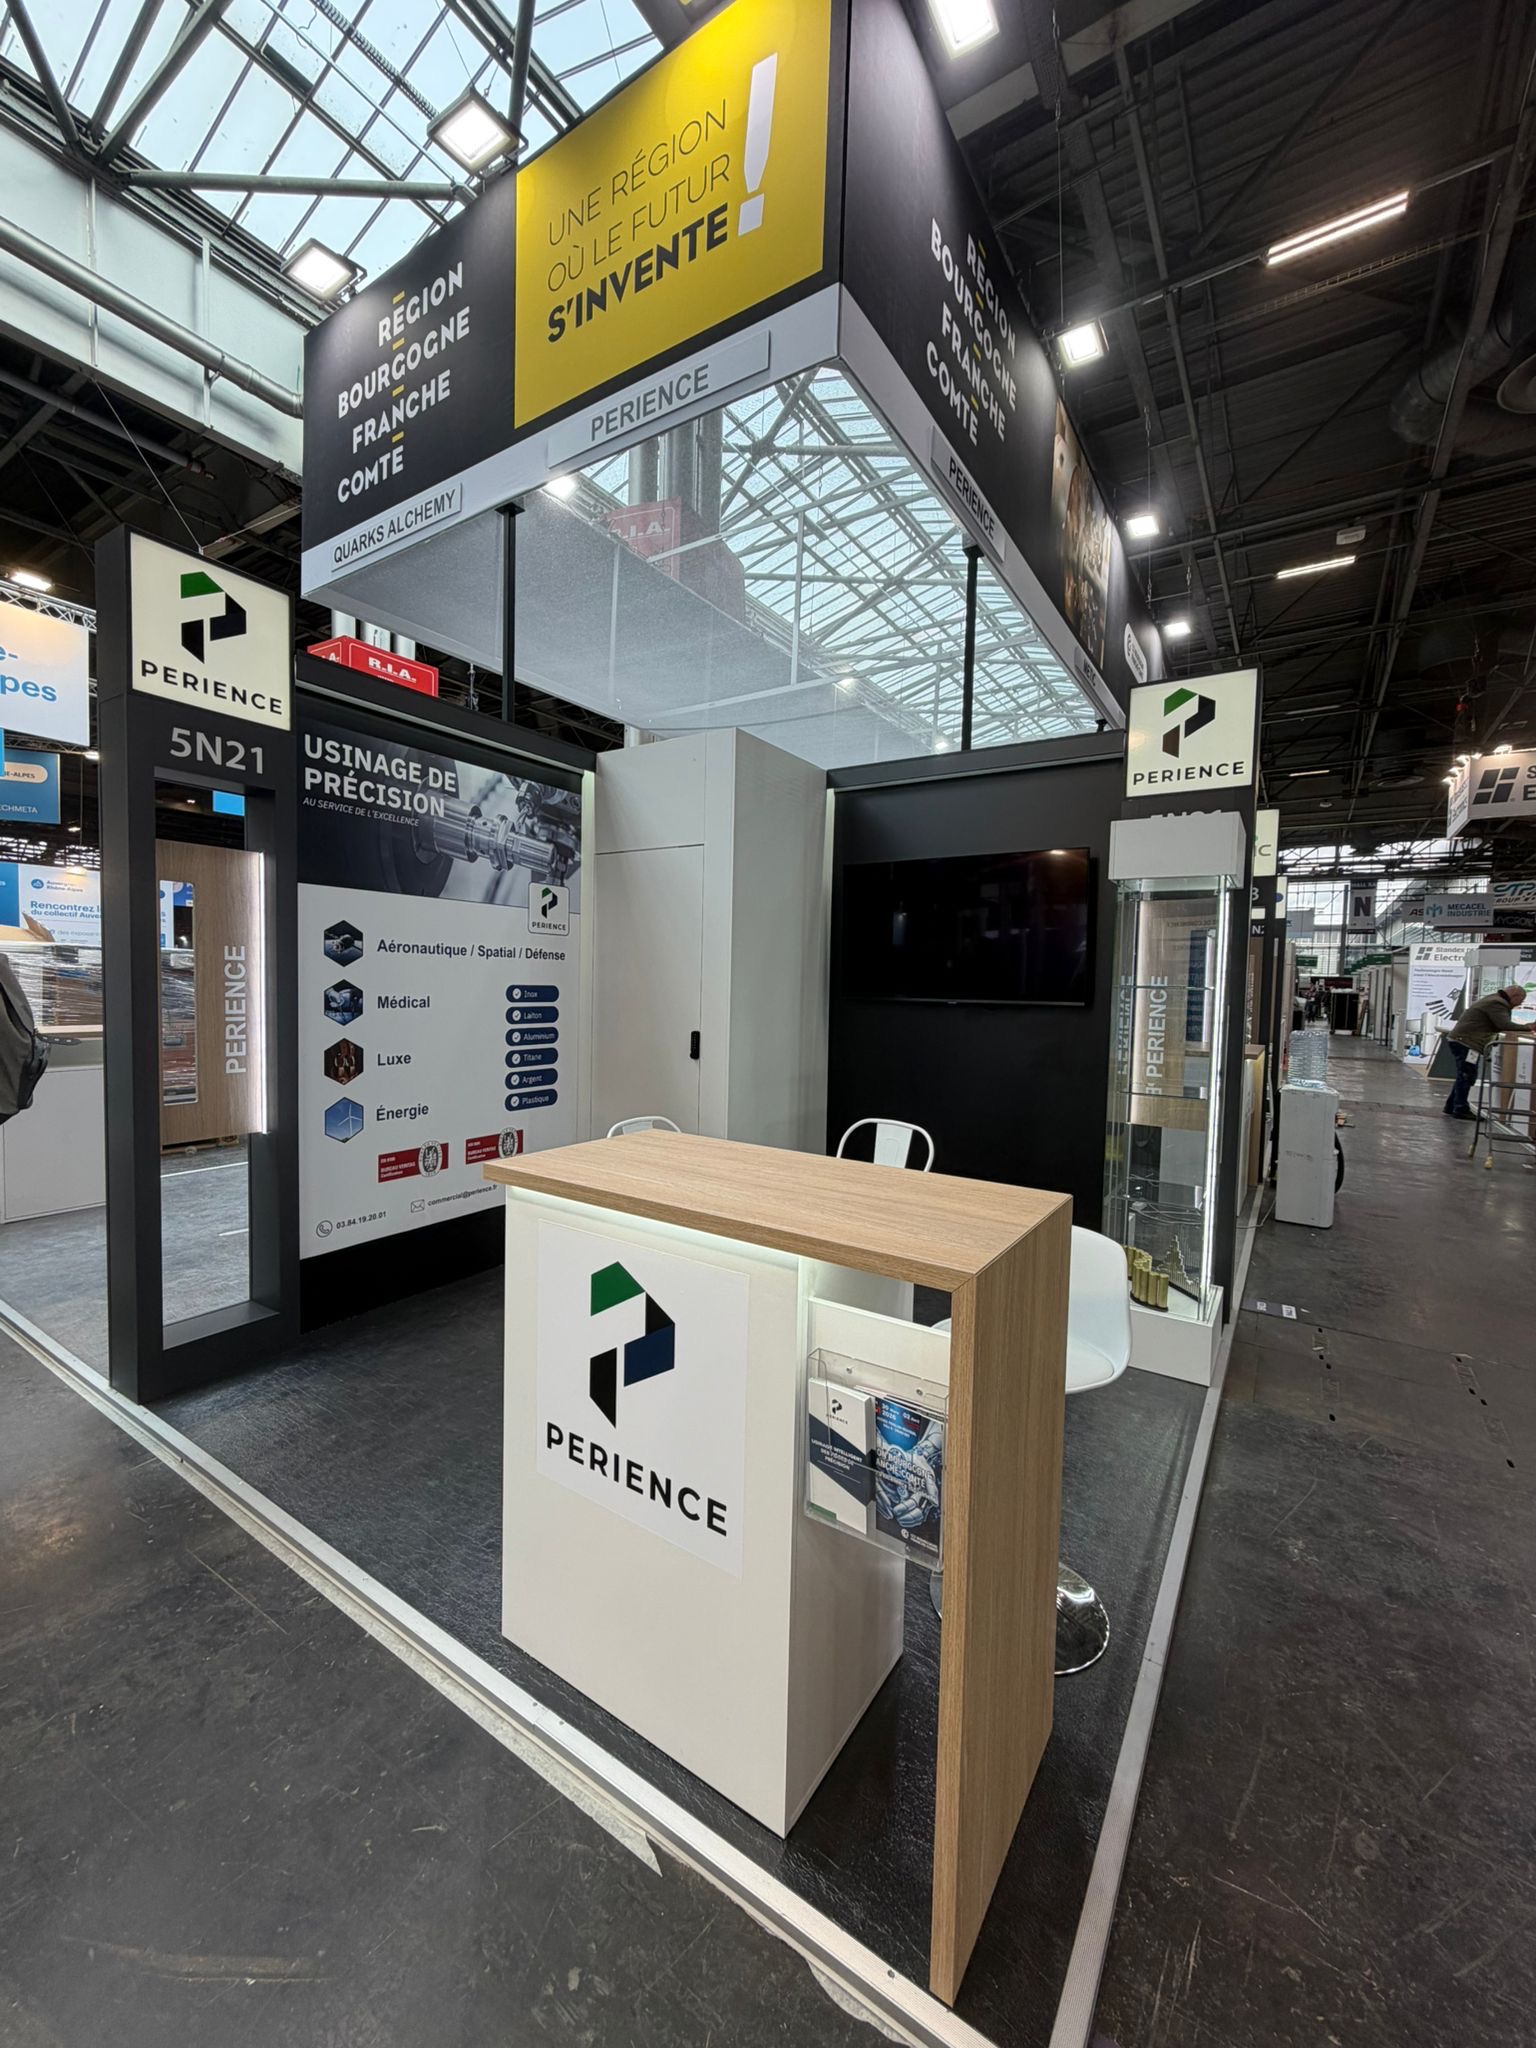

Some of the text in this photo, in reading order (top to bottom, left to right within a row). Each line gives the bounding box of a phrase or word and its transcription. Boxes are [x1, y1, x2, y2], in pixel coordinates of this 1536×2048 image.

[549, 98, 727, 246] UNE RÉGION
[547, 153, 730, 292] OÙ LE FUTUR
[547, 202, 729, 343] S'INVENTE
[931, 217, 1016, 412] BOURGOGNE
[338, 306, 470, 419] BOURGOGNE
[942, 301, 1005, 442] FRANCHE
[352, 369, 451, 453] FRANCHE
[591, 364, 709, 441] PERIENCE
[950, 458, 995, 540] PERIENCE
[333, 489, 456, 564] QUARKS ALCHEMY
[0, 674, 57, 702] pes
[140, 659, 283, 715] PERIENCE
[368, 656, 417, 684] R.I.A.
[170, 727, 264, 775] 5N21
[304, 734, 457, 792] USINAGE DE
[1133, 761, 1245, 785] PERIENCE
[303, 797, 420, 827] AU SERVICE DE L'EXCELLENCE
[304, 767, 445, 817] PRÉCISION
[31, 900, 94, 913] Rencontrez
[531, 921, 567, 931] PERIENCE
[1354, 896, 1371, 917] N
[377, 939, 468, 958] Aéronautique
[477, 945, 516, 960] Spatial
[525, 947, 566, 961] Défense
[224, 945, 247, 1074] PERIENCE
[377, 996, 430, 1009] Médical
[1146, 975, 1168, 1078] PERIENCE
[377, 1053, 412, 1067] Luxe
[523, 1031, 555, 1041] Aluminium
[522, 1074, 543, 1085] Argent
[376, 1104, 430, 1122] Énergie
[547, 1421, 727, 1537] PERIENCE
